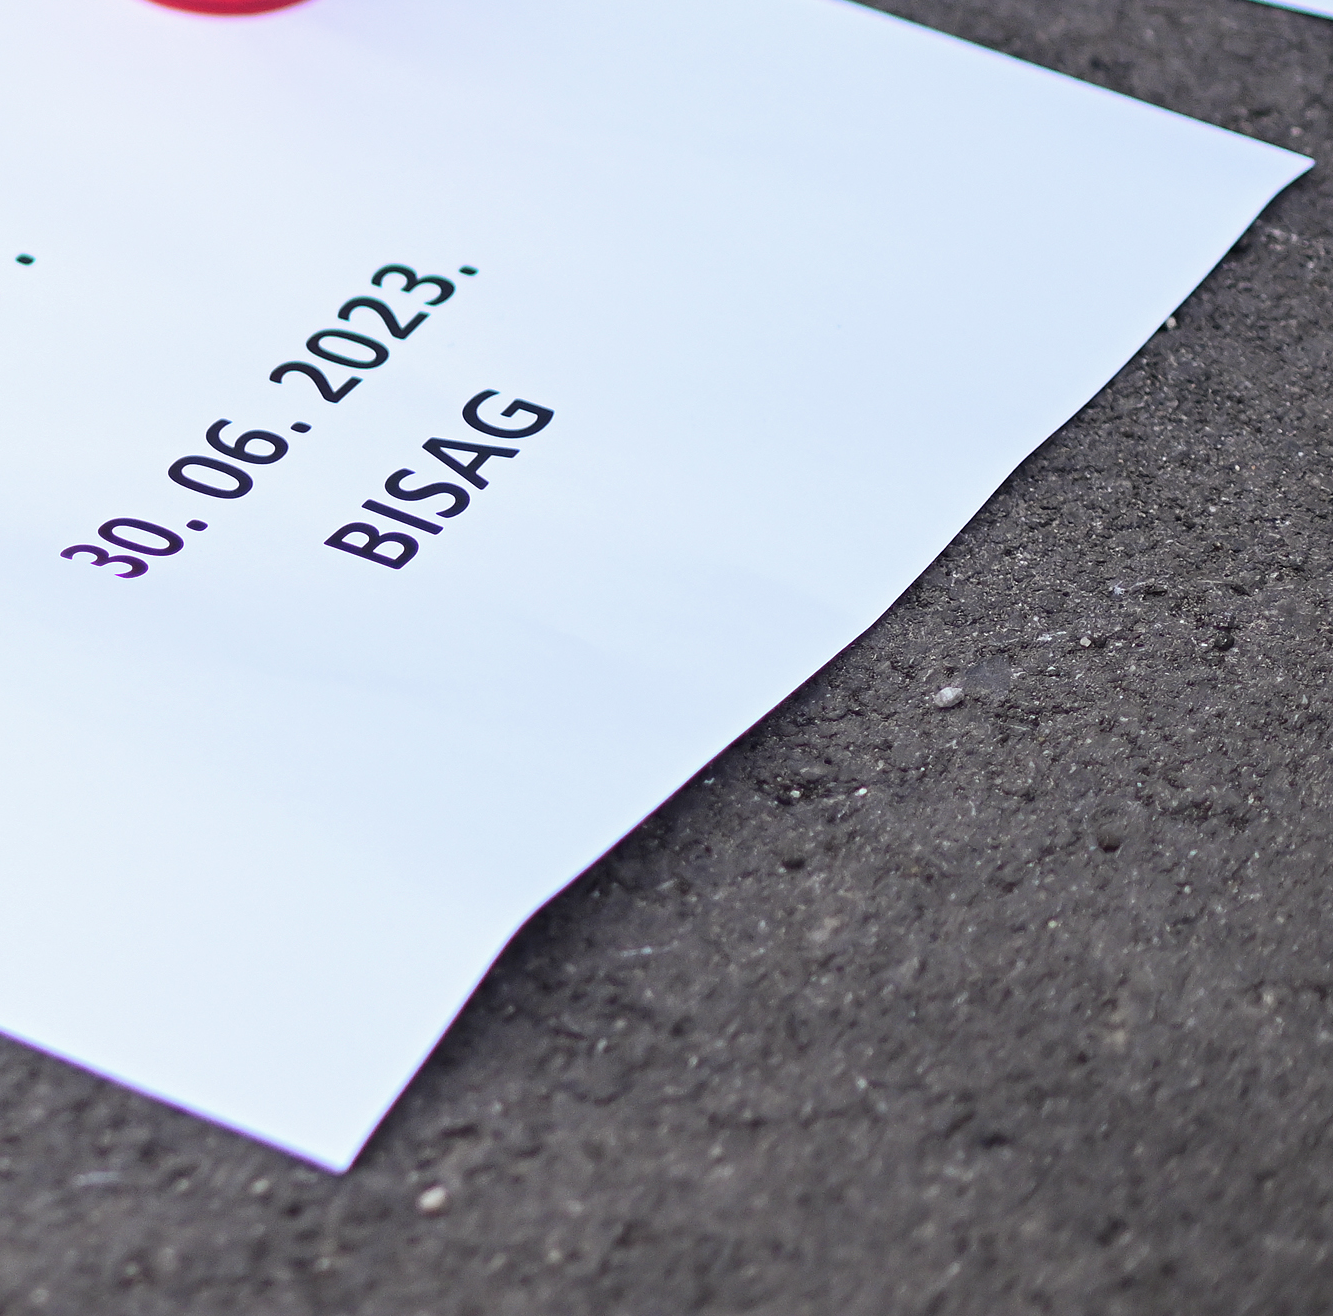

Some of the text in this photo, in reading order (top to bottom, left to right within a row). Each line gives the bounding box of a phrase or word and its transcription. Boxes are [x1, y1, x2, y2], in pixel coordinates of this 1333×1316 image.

[59, 263, 479, 579] 30. 06. 2023.
[323, 388, 555, 570] BISAG
